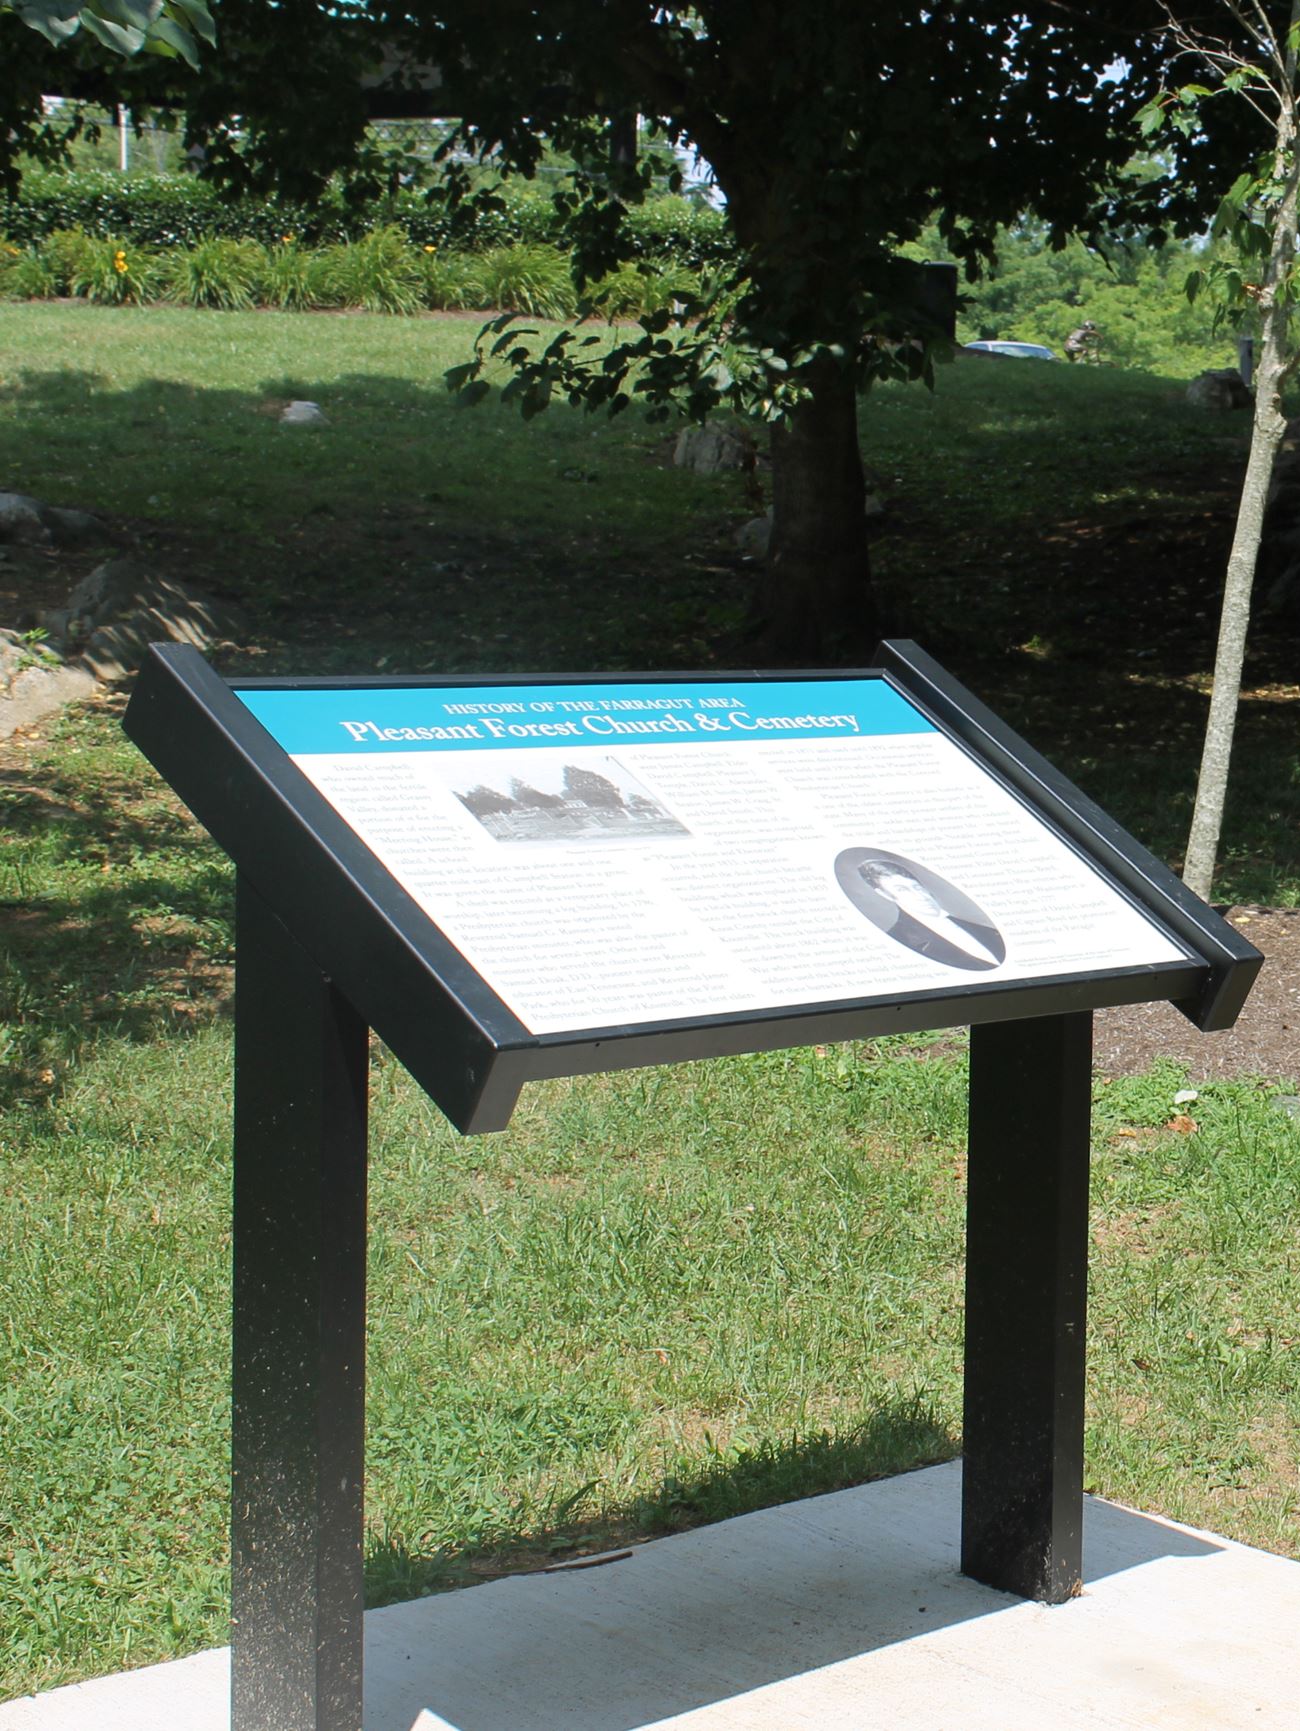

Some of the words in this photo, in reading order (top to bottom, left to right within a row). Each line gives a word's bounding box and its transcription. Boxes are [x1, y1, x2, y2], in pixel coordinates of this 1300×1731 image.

[443, 703, 527, 715] HISTORY
[530, 701, 554, 713] OF
[557, 700, 595, 712] THE
[598, 698, 694, 711] FARRAGUT
[697, 697, 747, 709] AREA
[339, 720, 485, 742] Pleasant
[479, 717, 584, 738] Forest
[582, 713, 696, 735] Church
[694, 712, 730, 732] &
[728, 711, 860, 732] Cemetery
